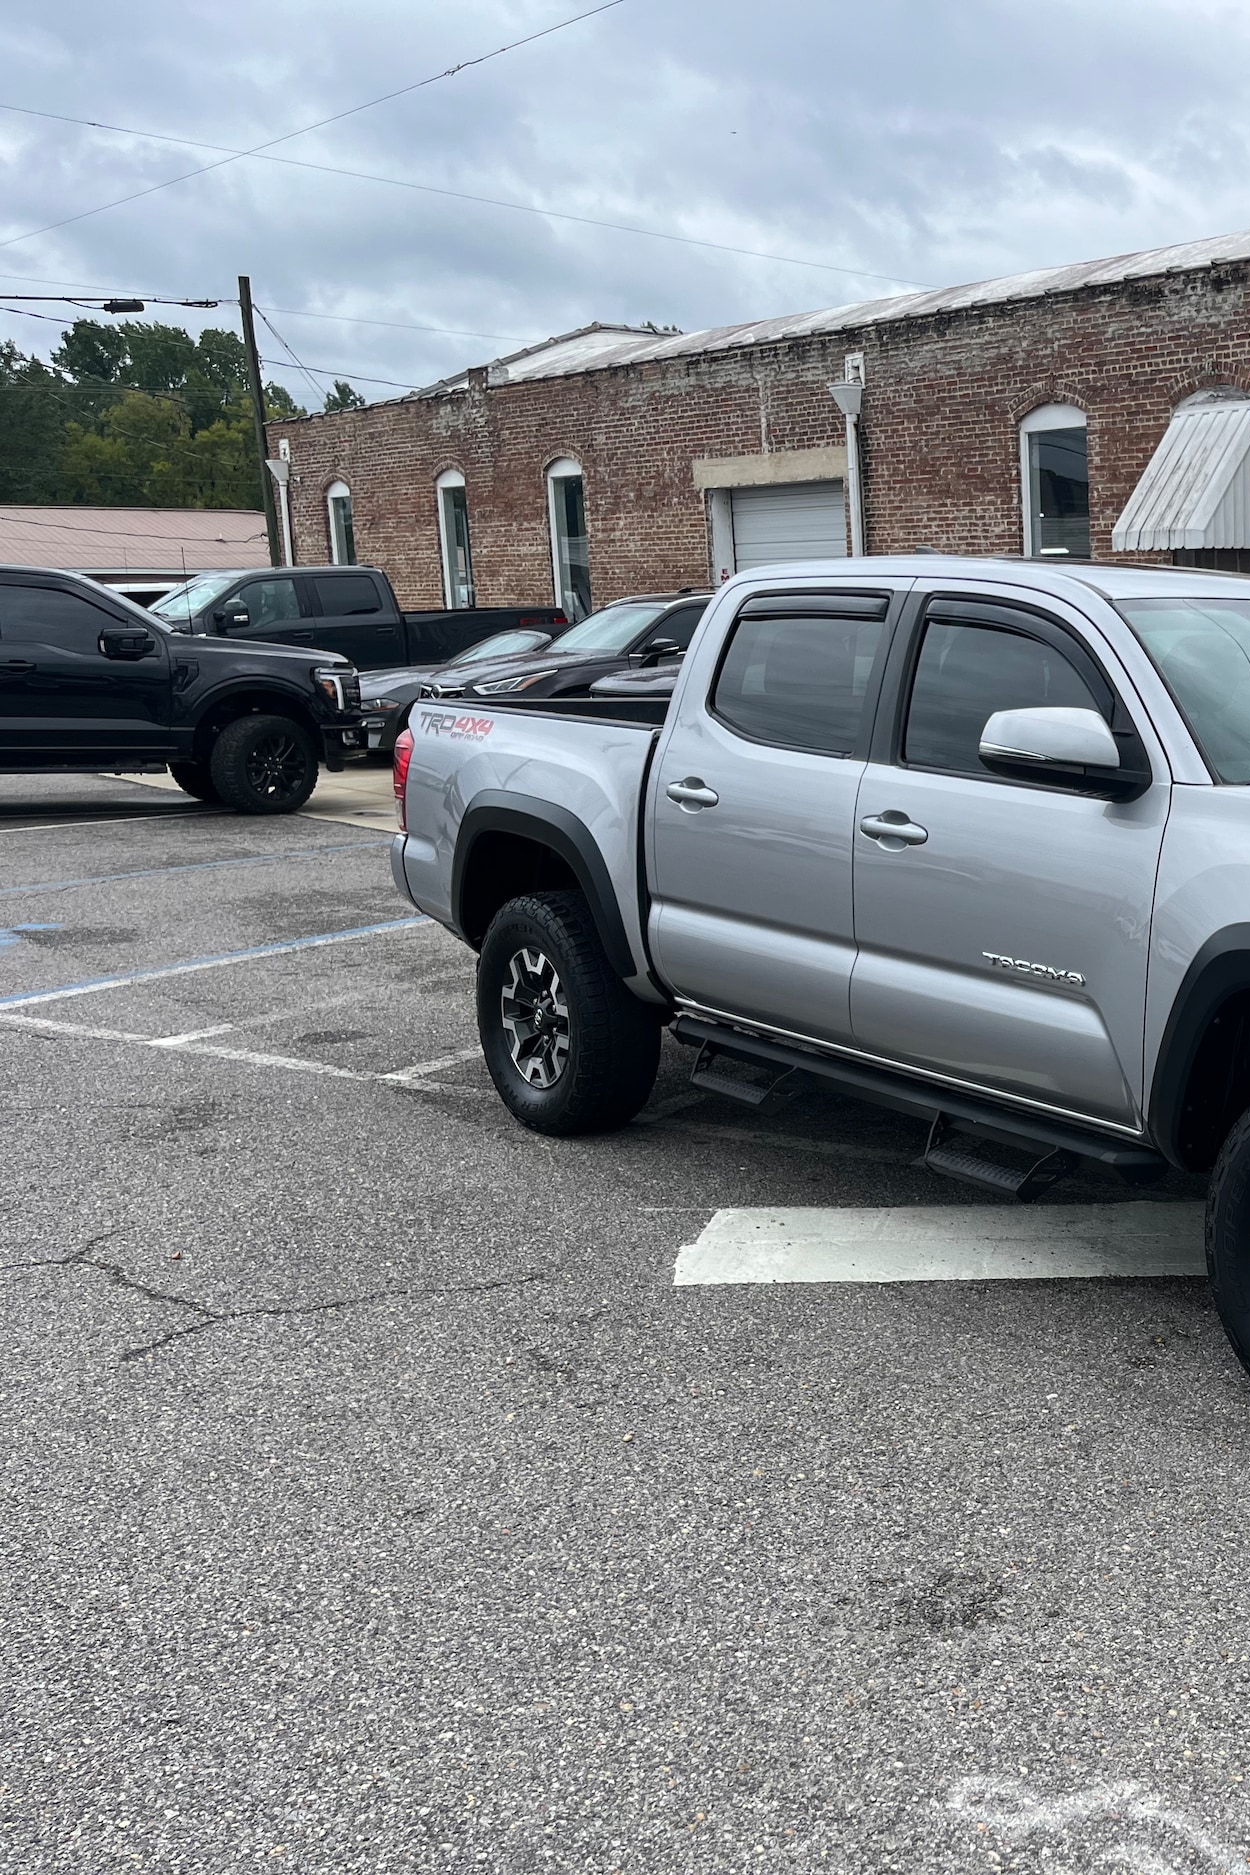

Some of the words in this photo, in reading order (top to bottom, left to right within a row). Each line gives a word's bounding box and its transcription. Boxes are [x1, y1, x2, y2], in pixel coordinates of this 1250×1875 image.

[420, 711, 457, 736] TRD
[450, 731, 465, 739] OFF
[464, 734, 484, 742] ROAD
[982, 951, 1086, 986] TACOMA
